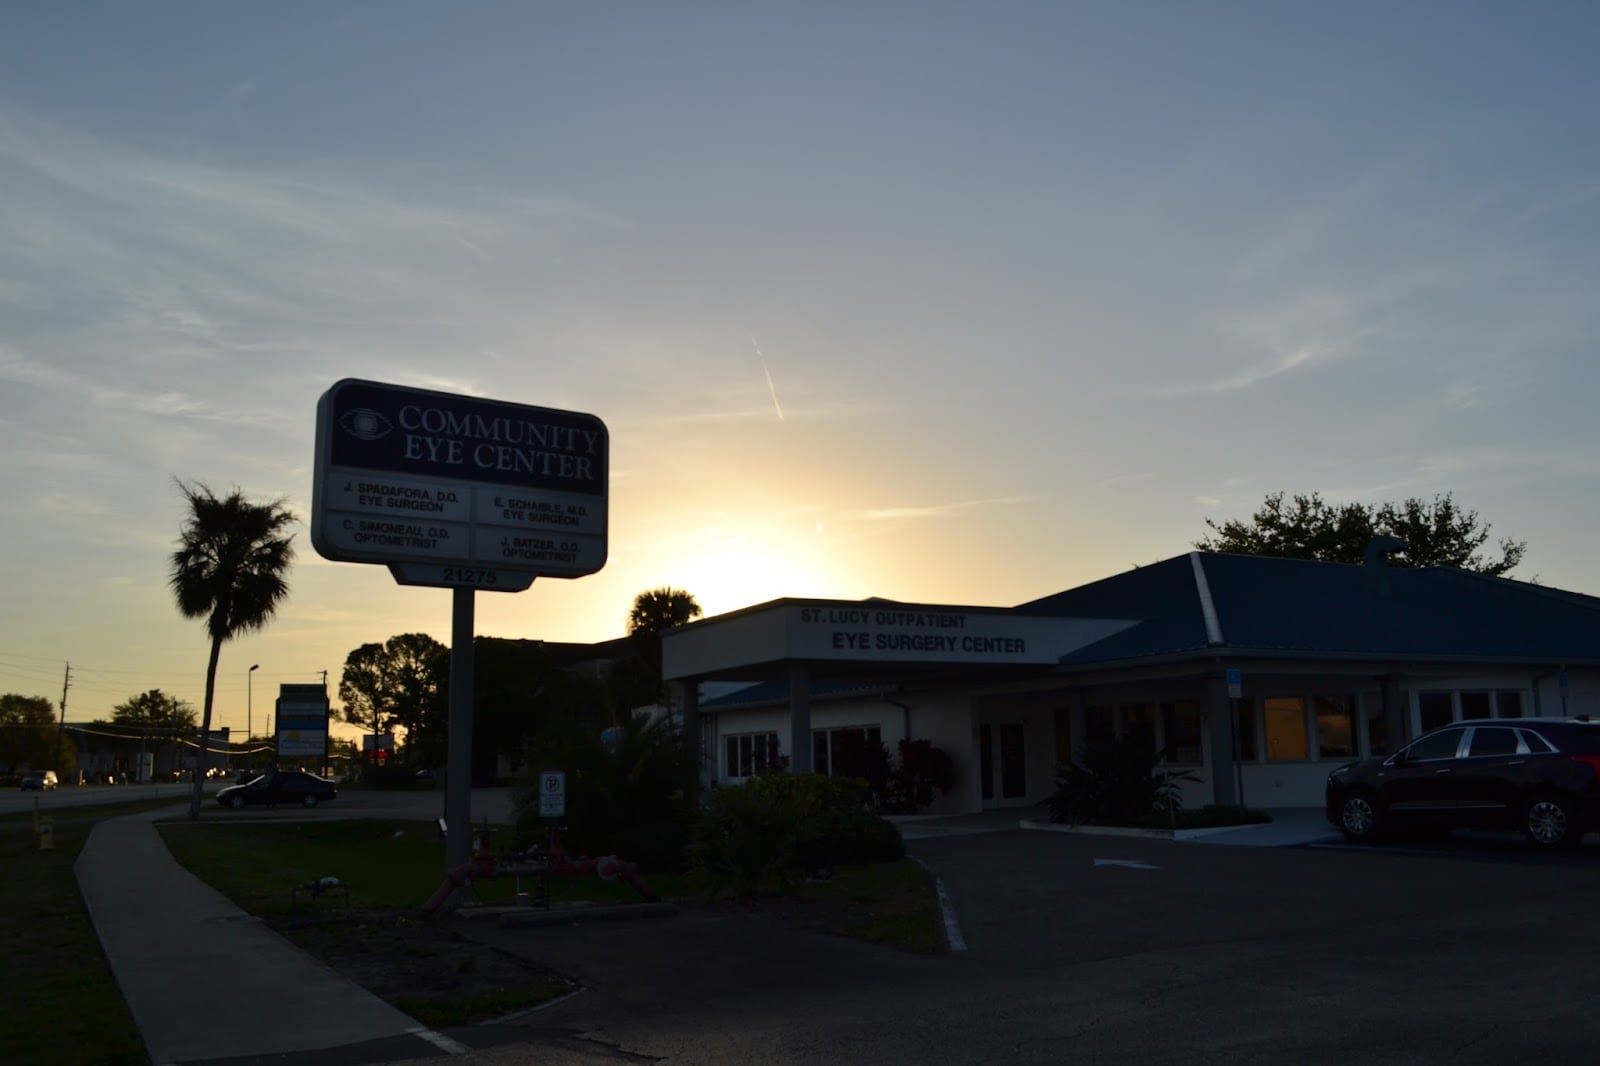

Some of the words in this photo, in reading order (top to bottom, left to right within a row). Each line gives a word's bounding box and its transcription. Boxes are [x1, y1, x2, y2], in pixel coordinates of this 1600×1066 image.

[399, 405, 598, 454] COMMUNITY
[402, 434, 464, 464] EYE
[473, 443, 593, 480] CENTER
[344, 482, 352, 492] J.
[358, 483, 432, 500] SPADAFORA,
[359, 495, 383, 507] EYE
[387, 497, 443, 512] SURGEON
[343, 519, 354, 530] C.
[503, 509, 525, 521] EYE
[528, 511, 579, 526] SURGEON
[354, 532, 438, 549] OPTOMETRIST
[503, 548, 577, 564] OPTOMETRIST
[443, 567, 497, 584] 21275
[875, 611, 966, 629] OUTPATIENT
[832, 632, 871, 650] EYE
[875, 634, 957, 653] SURGERY
[962, 636, 1025, 654] CENTER
